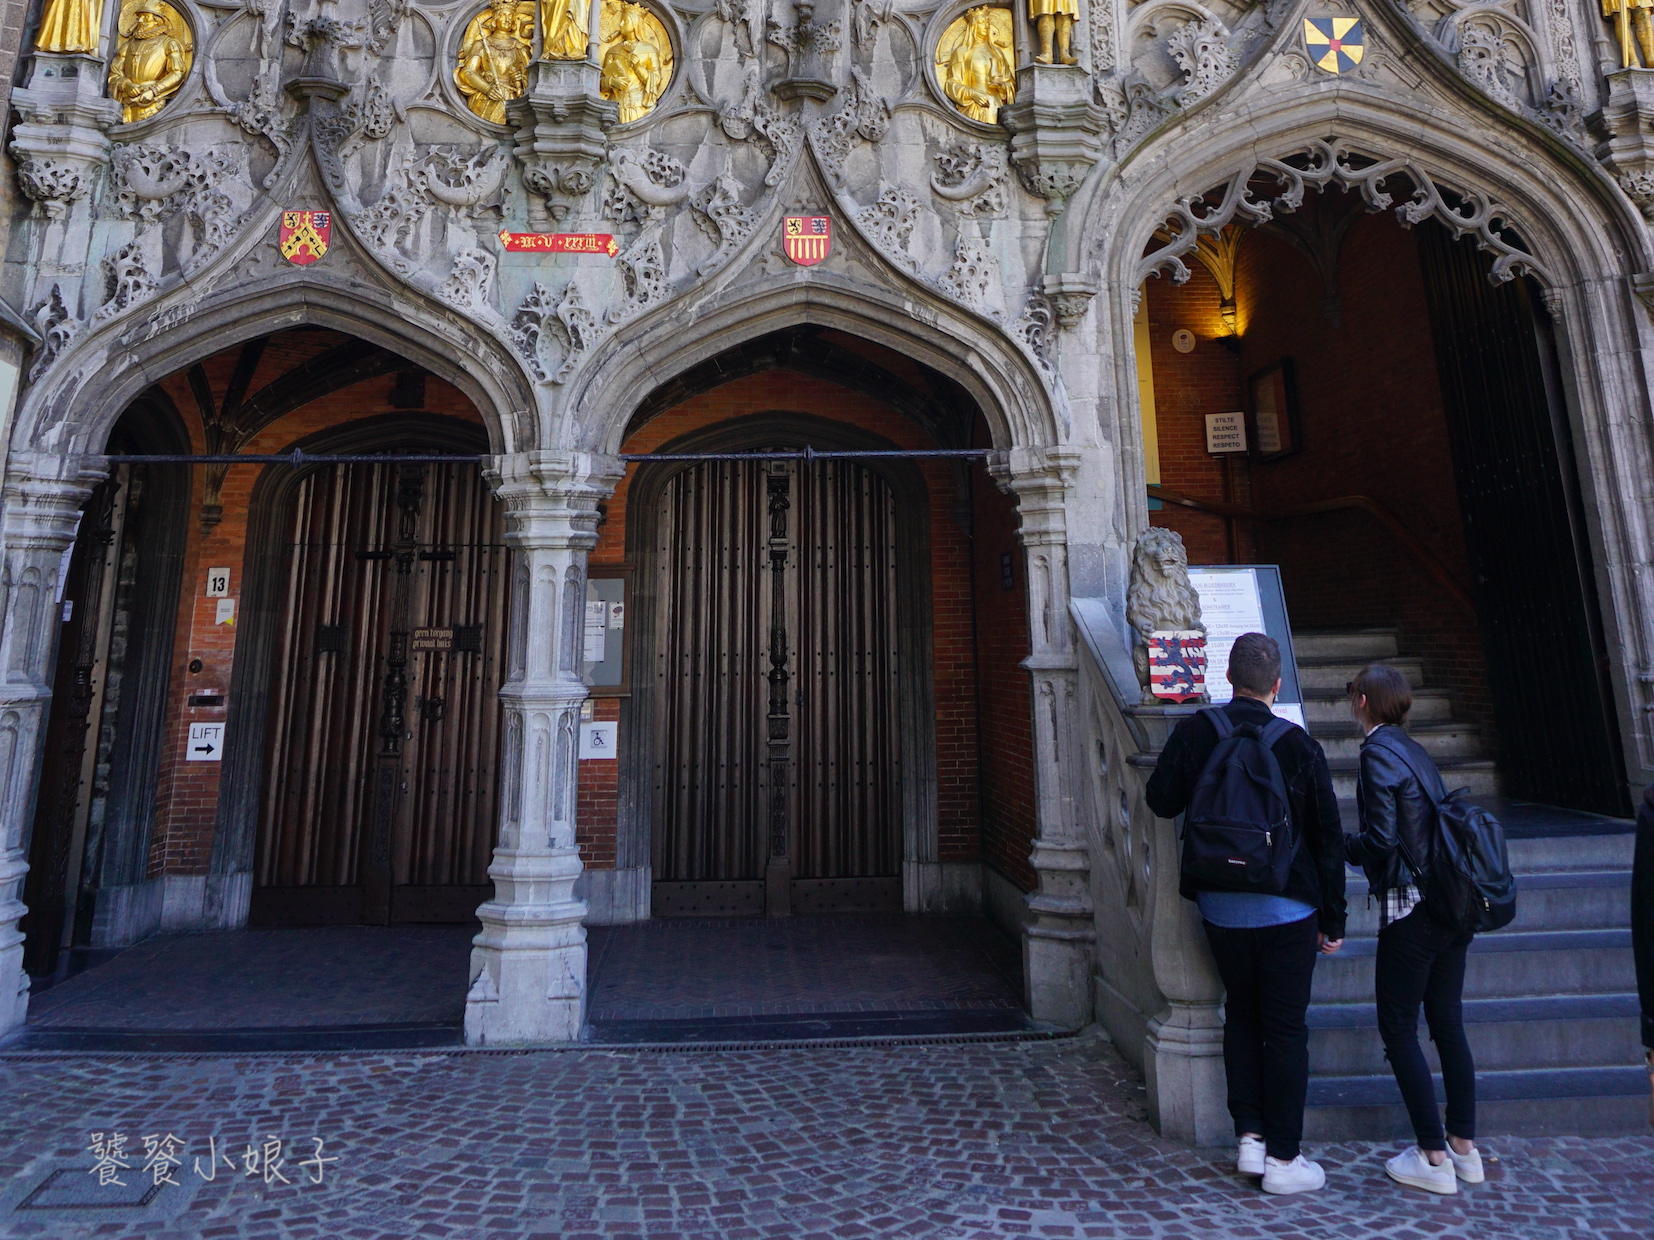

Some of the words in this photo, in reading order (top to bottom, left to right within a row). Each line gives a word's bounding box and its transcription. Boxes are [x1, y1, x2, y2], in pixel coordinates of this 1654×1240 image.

[1215, 416, 1235, 424] STILTE
[1213, 441, 1241, 449] RESPETO
[212, 576, 225, 592] 13
[192, 727, 221, 740] LIFT
